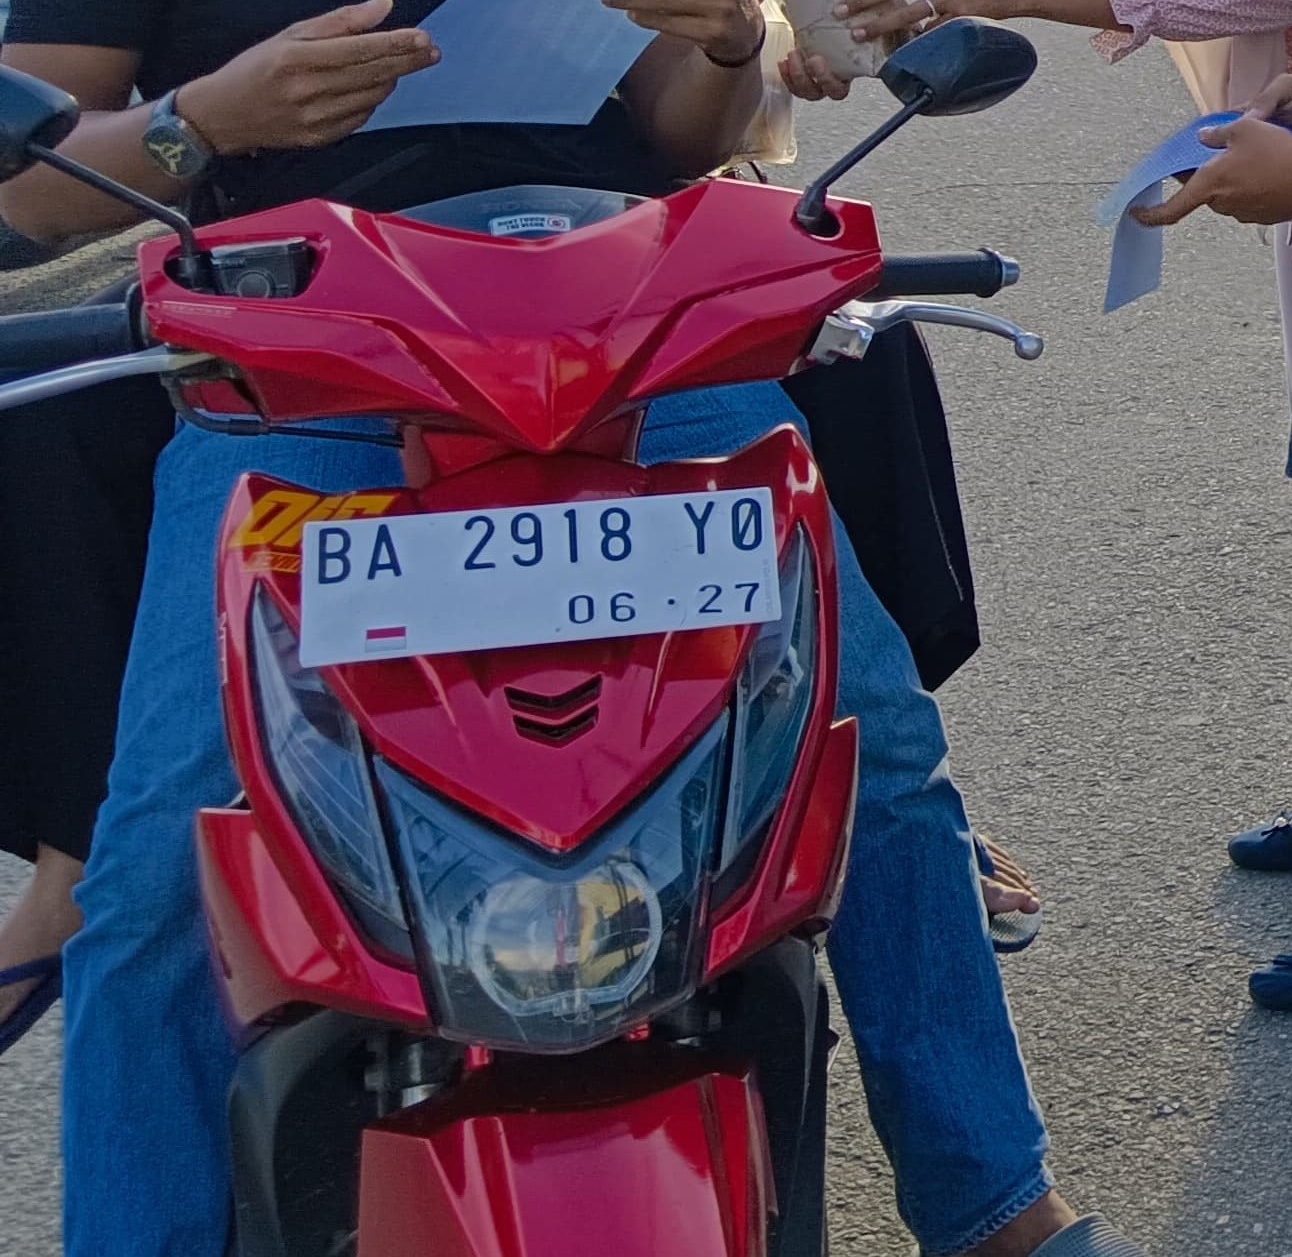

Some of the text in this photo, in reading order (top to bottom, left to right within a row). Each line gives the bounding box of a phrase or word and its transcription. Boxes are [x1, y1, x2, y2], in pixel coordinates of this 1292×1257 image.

[316, 523, 403, 586] BA
[462, 506, 632, 571] 2918
[567, 591, 637, 625] 06
[697, 582, 761, 615] 27
